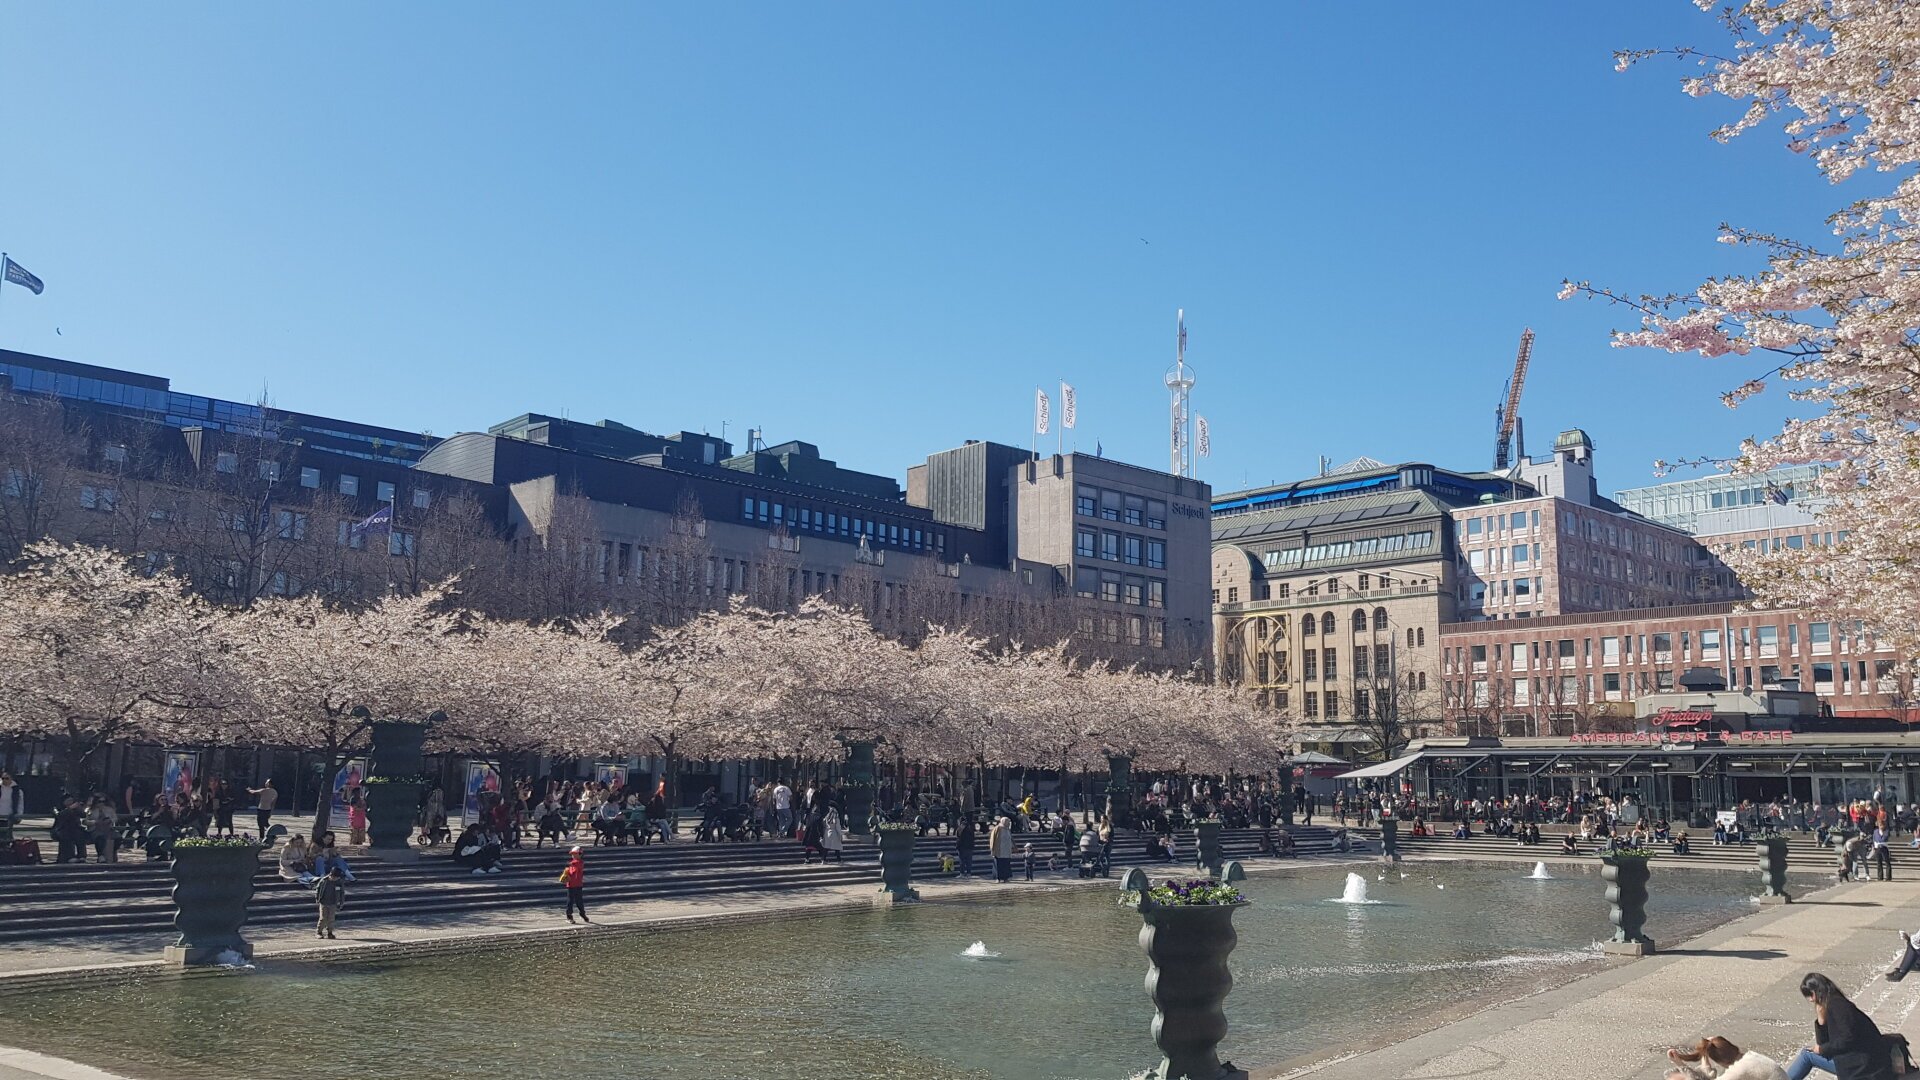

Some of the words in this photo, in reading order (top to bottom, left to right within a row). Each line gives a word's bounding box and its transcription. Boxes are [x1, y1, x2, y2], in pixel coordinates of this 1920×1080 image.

[1569, 732, 1661, 743] AMERICAN
[1669, 731, 1708, 742] BAR
[1719, 729, 1731, 741] &
